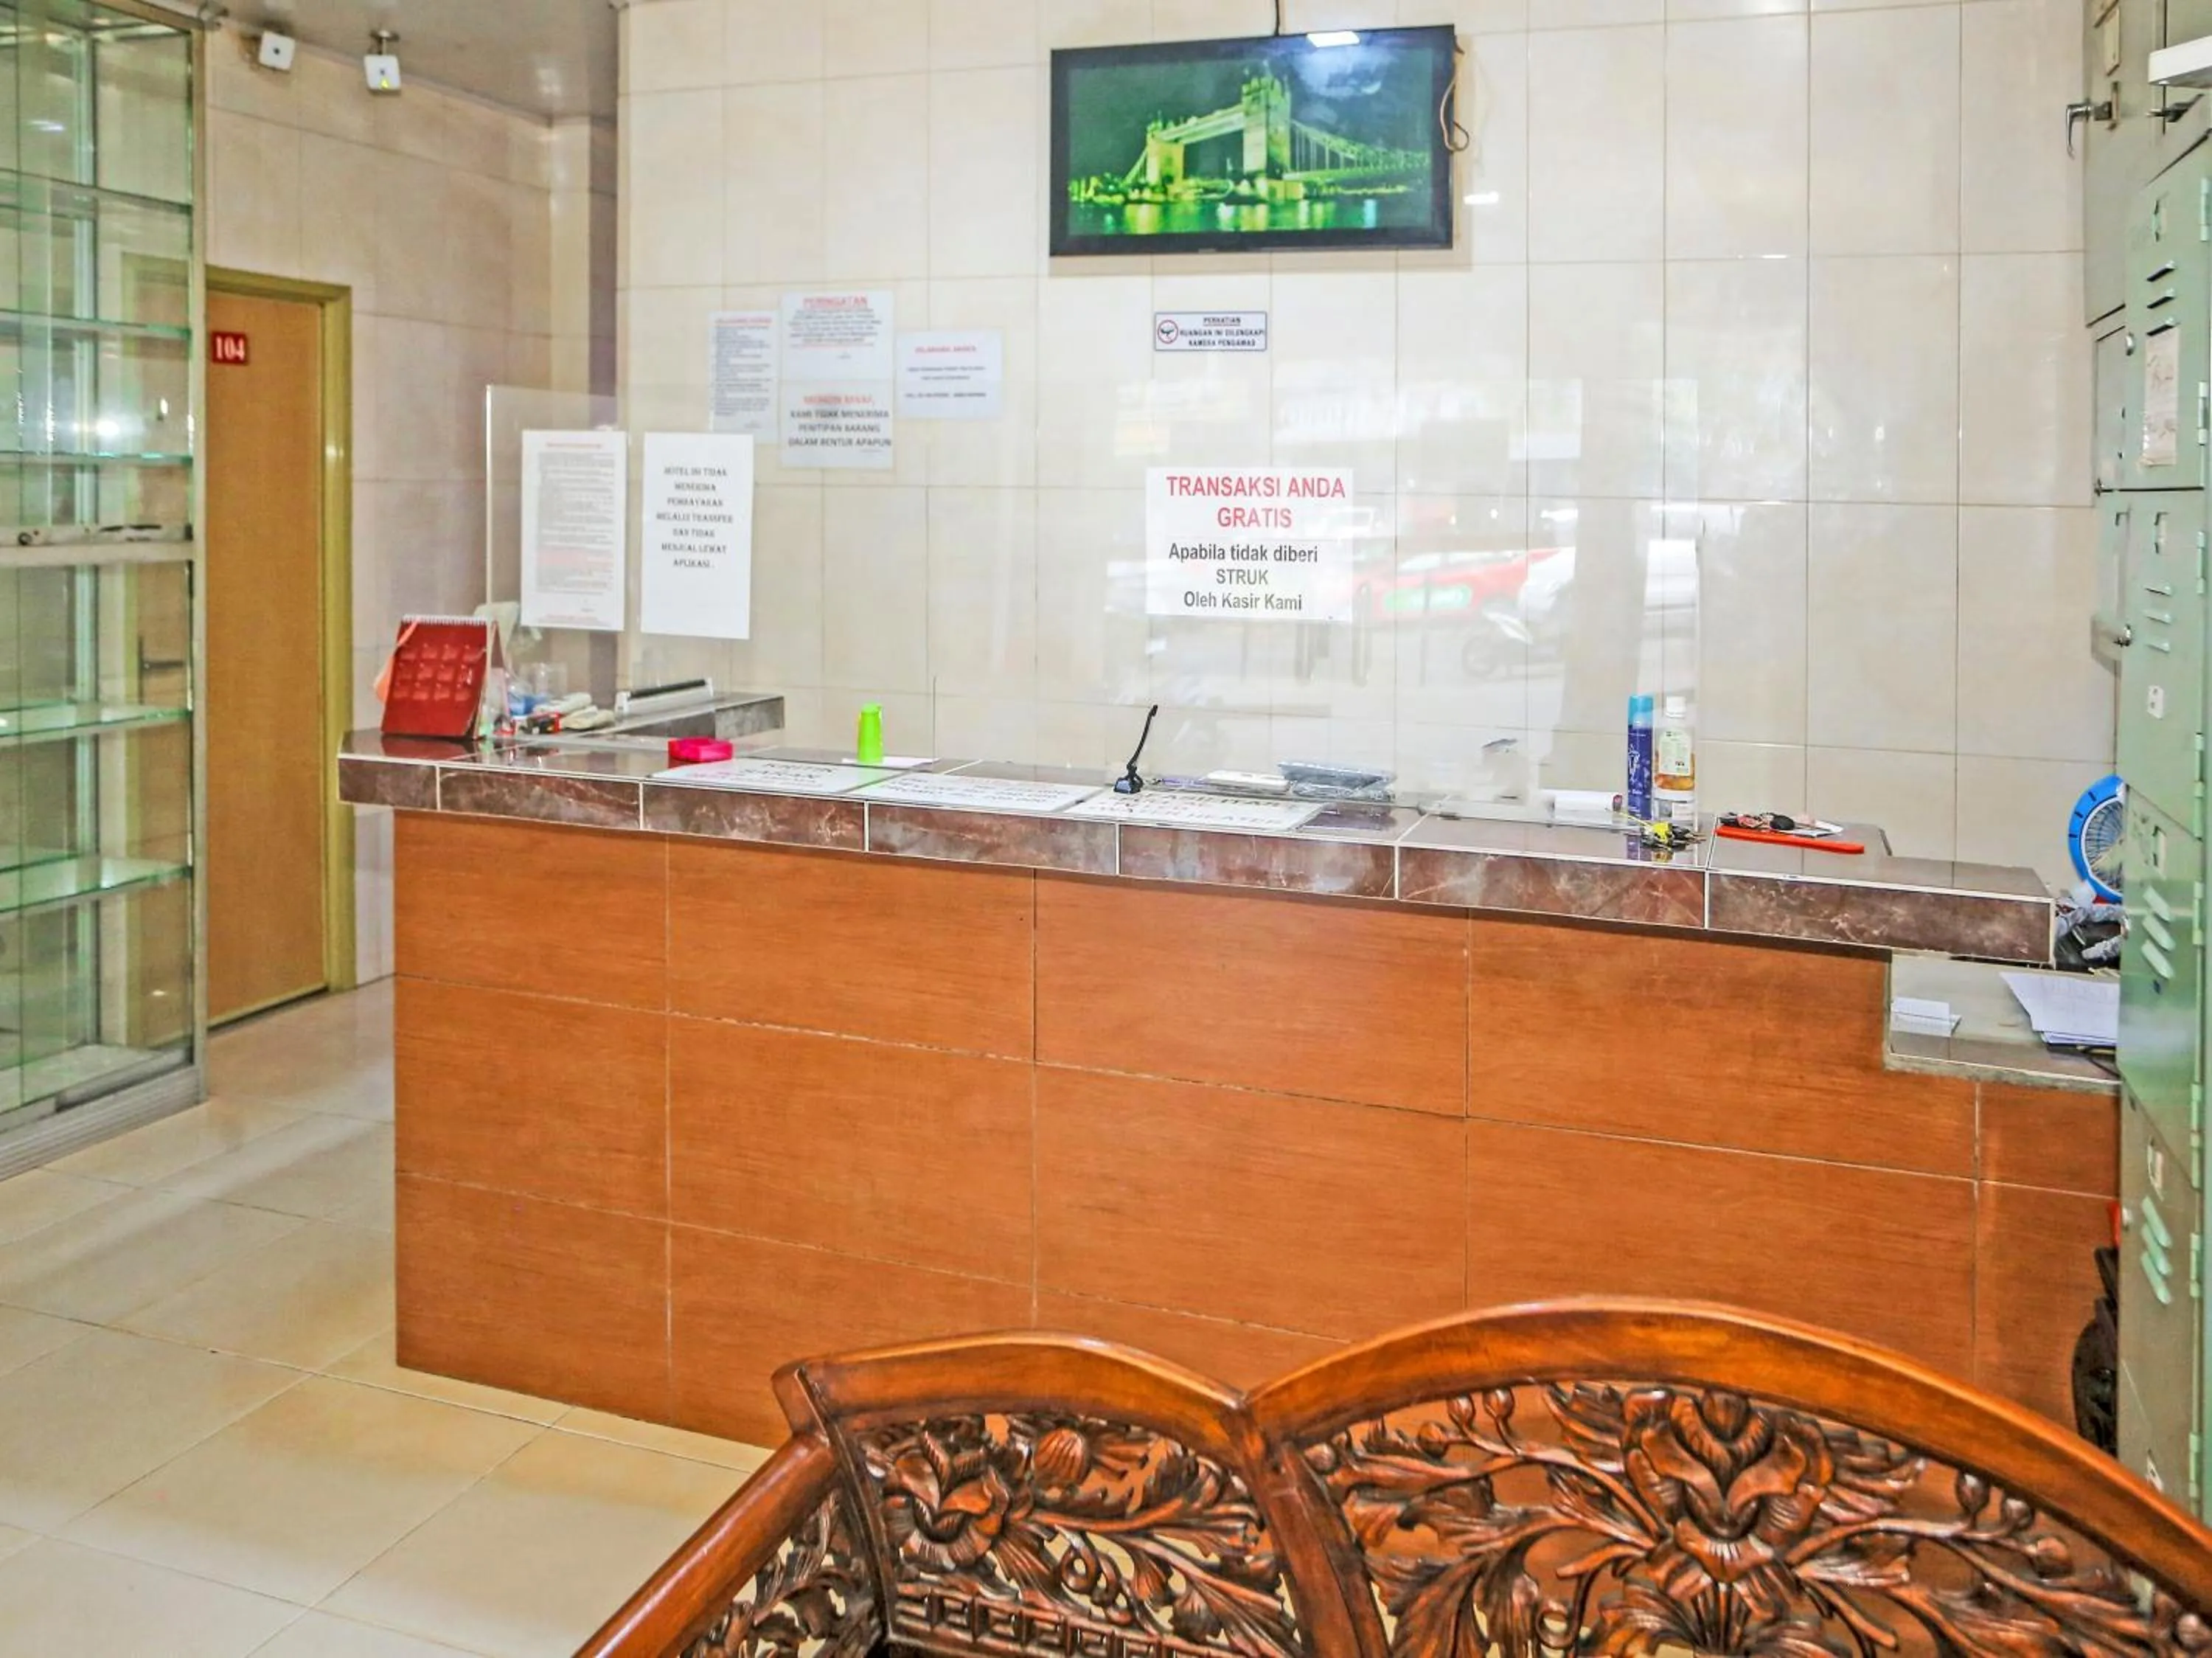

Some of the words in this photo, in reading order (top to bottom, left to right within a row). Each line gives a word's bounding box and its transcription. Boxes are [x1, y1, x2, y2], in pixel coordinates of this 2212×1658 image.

[216, 336, 245, 361] 104
[790, 410, 813, 419] KAMI
[814, 409, 839, 419] TIDAK
[841, 410, 890, 419] MENERIMA
[798, 423, 842, 433] PENITIPAN
[844, 423, 881, 433] BARANG
[787, 437, 818, 447] DALAM
[820, 437, 853, 447] BENTUK
[855, 437, 892, 447] APAPUN
[663, 467, 689, 476] HOTEL
[703, 467, 727, 476] TIDAK
[1166, 476, 1281, 497] TRANSAKSI
[1287, 477, 1346, 499] ANDA
[667, 497, 723, 507] PEMBAYARAN
[1217, 506, 1293, 528] GRATIS
[672, 527, 689, 537] DAN
[692, 528, 715, 538] TIDAK
[699, 544, 726, 554] LEWAT
[1168, 543, 1225, 563] Apabila
[1230, 544, 1269, 561] tidak
[1273, 545, 1318, 563] diberi
[1216, 568, 1269, 585] STRUK
[1183, 591, 1217, 608] Oleh
[1222, 592, 1260, 609] Kasir
[1265, 593, 1303, 611] Kami
